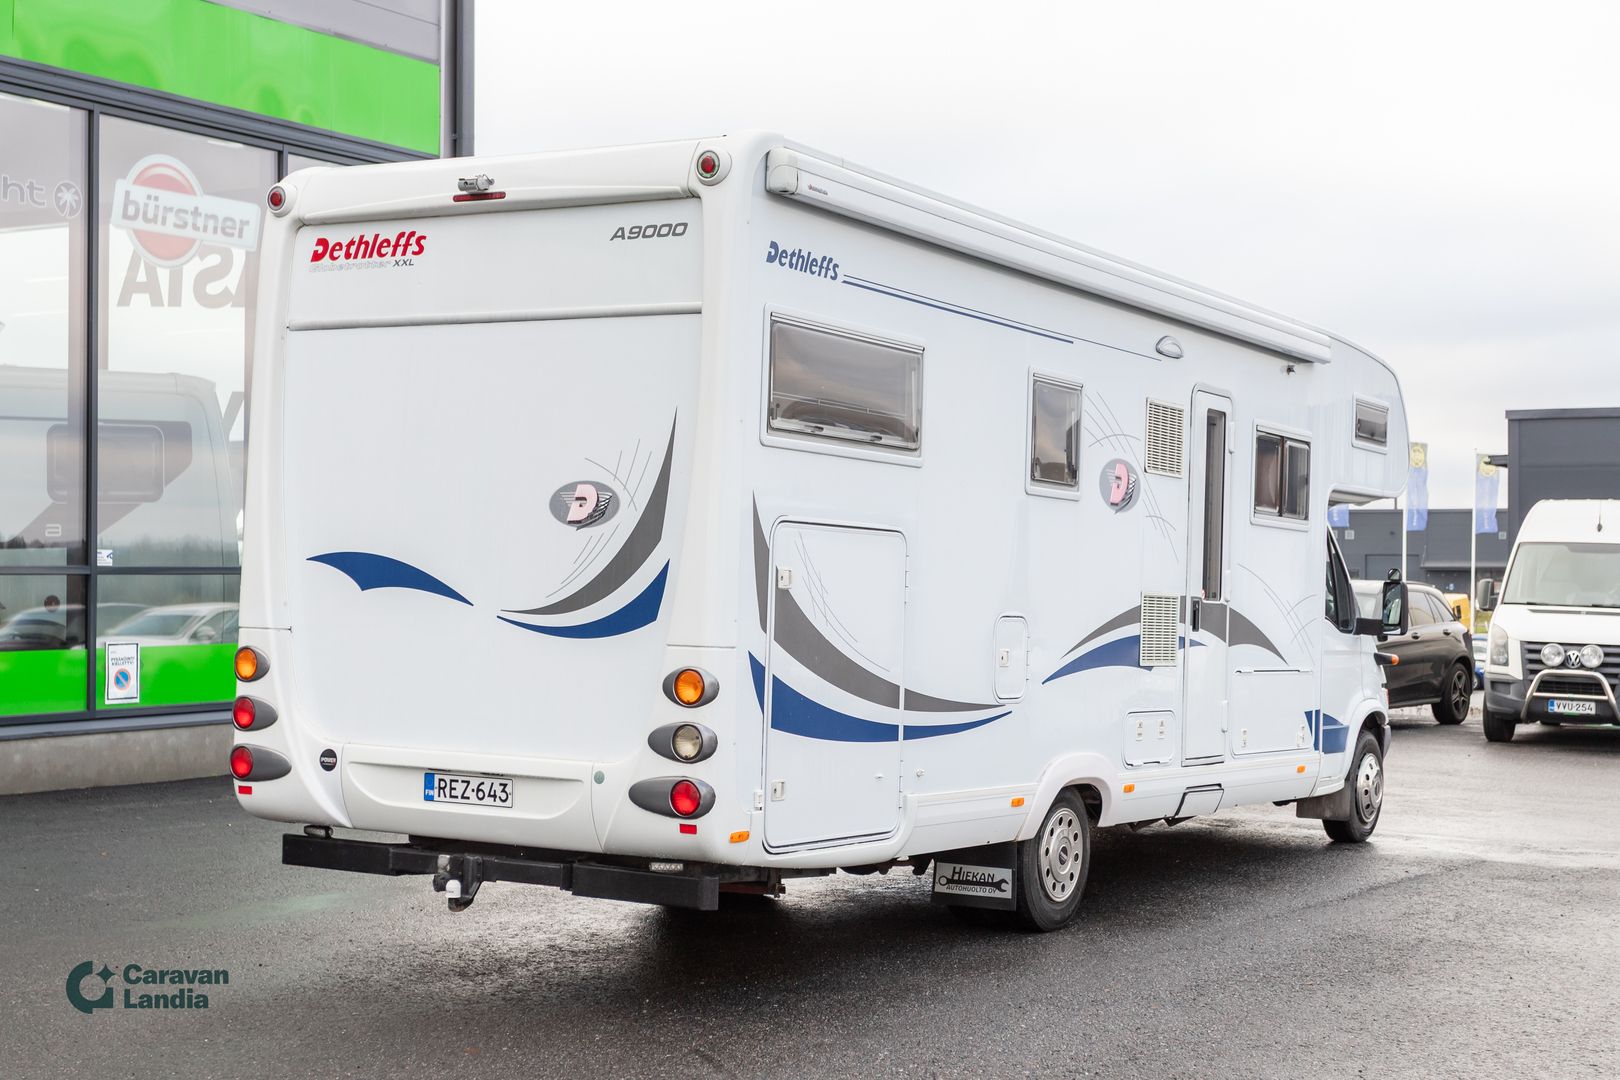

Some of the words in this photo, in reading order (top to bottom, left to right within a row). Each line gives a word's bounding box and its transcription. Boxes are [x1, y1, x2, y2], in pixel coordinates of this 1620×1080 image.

[122, 190, 250, 239] bürstner
[609, 222, 689, 241] A9000
[310, 230, 427, 262] Dethleffs
[392, 258, 415, 268] XXL
[765, 240, 839, 281] Dethleffs
[437, 778, 509, 803] REZ-643
[951, 866, 995, 882] HIEKAN
[946, 885, 987, 893] AUTOHUOLTO
